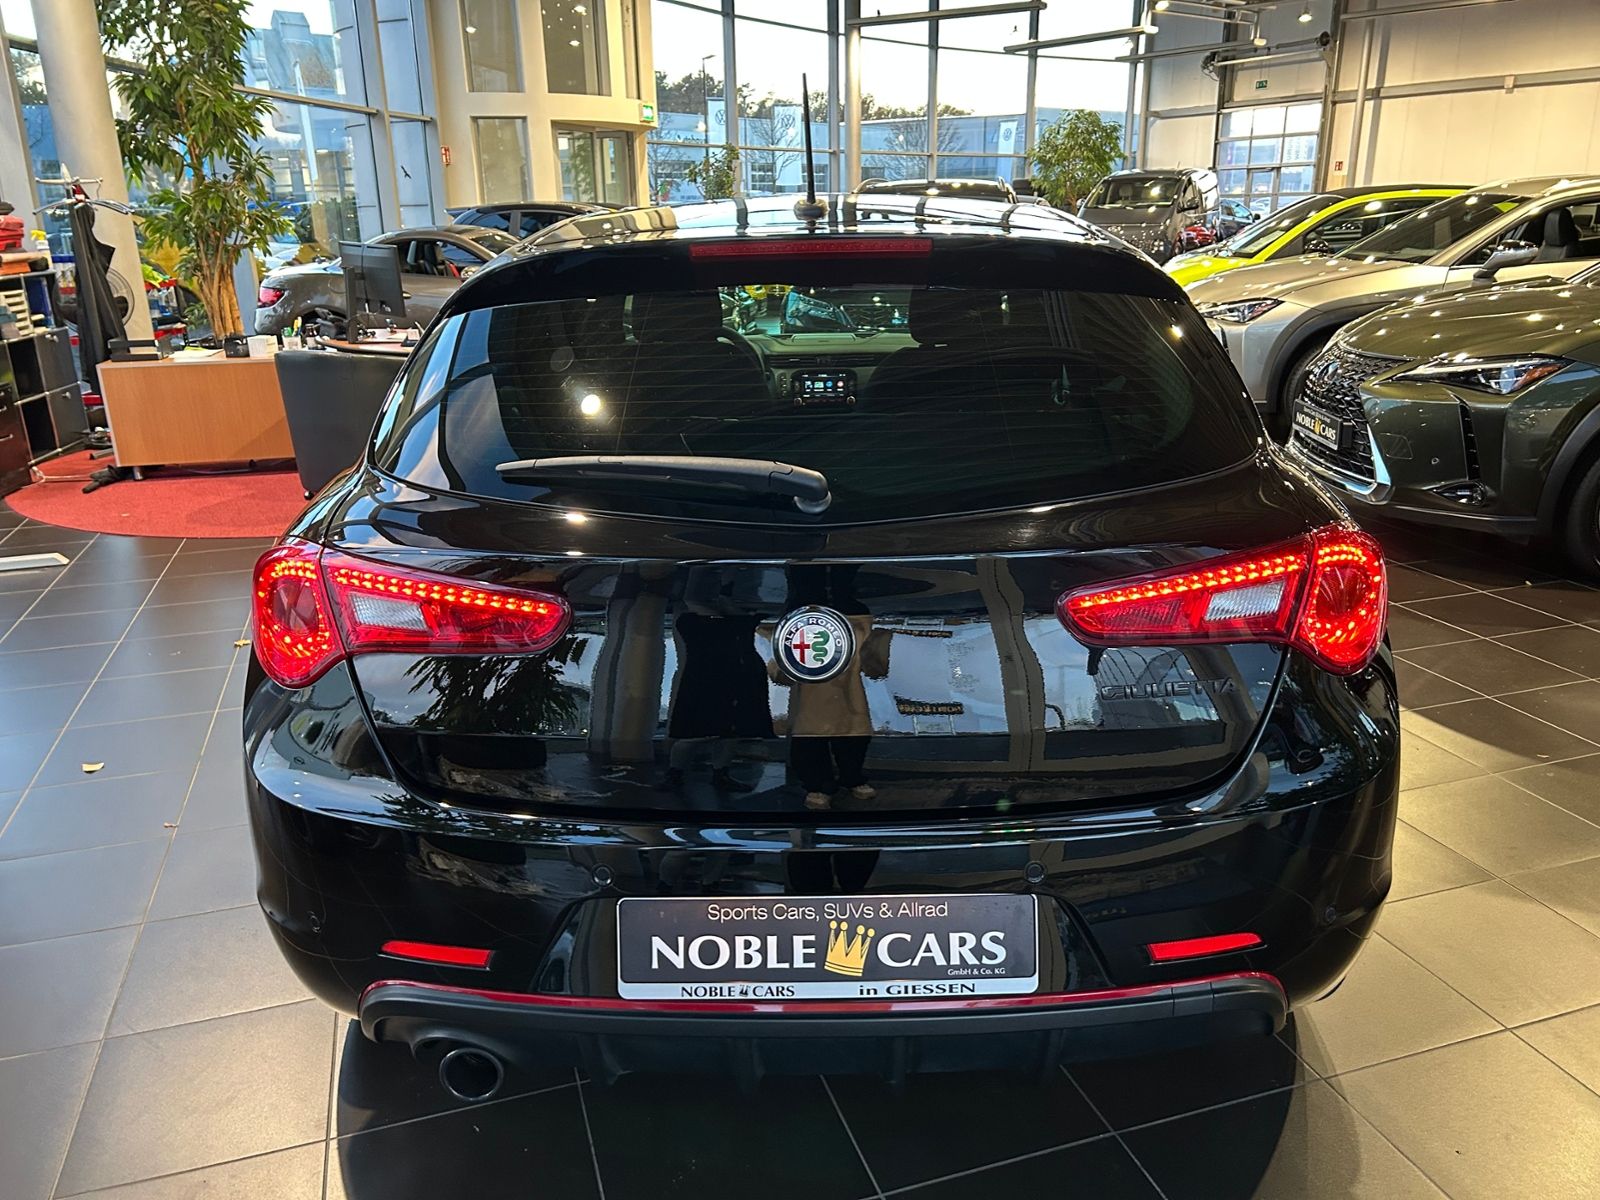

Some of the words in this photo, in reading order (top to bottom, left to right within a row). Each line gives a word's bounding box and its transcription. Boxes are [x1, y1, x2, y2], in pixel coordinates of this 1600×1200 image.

[1296, 412, 1315, 430] NOBLE
[1320, 423, 1336, 441] CARS
[785, 621, 804, 647] ALFA
[809, 618, 842, 647] ROMEO
[1101, 677, 1239, 700] GIULIETTA
[707, 903, 768, 922] Sports
[772, 902, 820, 921] Cars,
[823, 902, 874, 919] SUVs
[879, 902, 894, 918] &
[897, 901, 949, 918] Allrad
[650, 934, 817, 969] NOBLE
[877, 932, 1007, 967] CARS
[980, 967, 993, 975] Co.
[994, 967, 1006, 975] KG
[681, 985, 736, 997] NOBLE
[753, 985, 796, 997] CARS
[859, 985, 878, 996] in
[886, 983, 976, 995] GIESSEN
